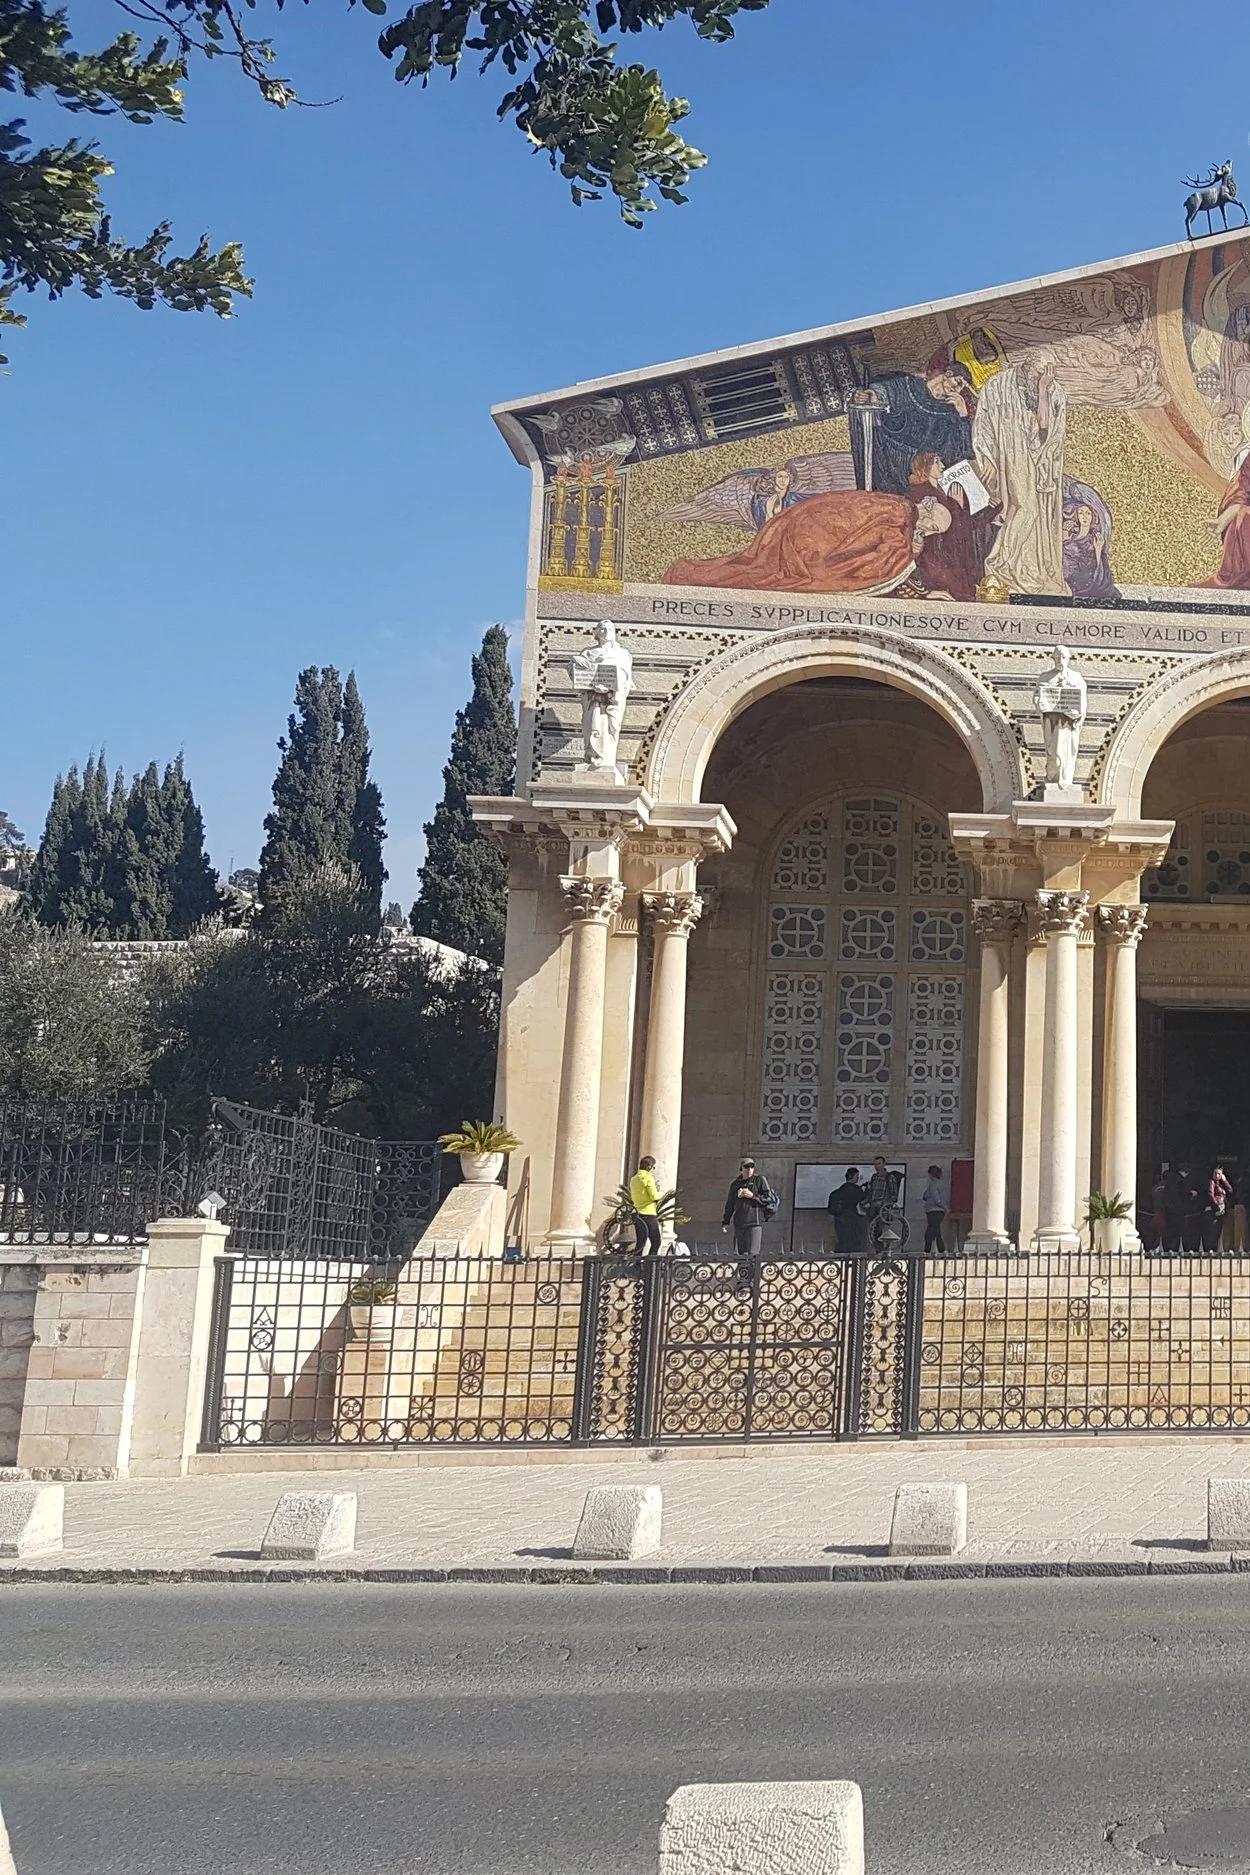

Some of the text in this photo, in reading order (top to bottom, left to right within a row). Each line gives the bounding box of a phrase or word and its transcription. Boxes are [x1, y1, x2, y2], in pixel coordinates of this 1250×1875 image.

[651, 600, 735, 618] PRECES
[750, 605, 970, 631] SVPPLICATIONESQVE
[983, 618, 1022, 634] CVM
[1035, 621, 1127, 640] CLAMORE
[1140, 626, 1208, 642] VALIDO
[1220, 631, 1244, 644] ET
